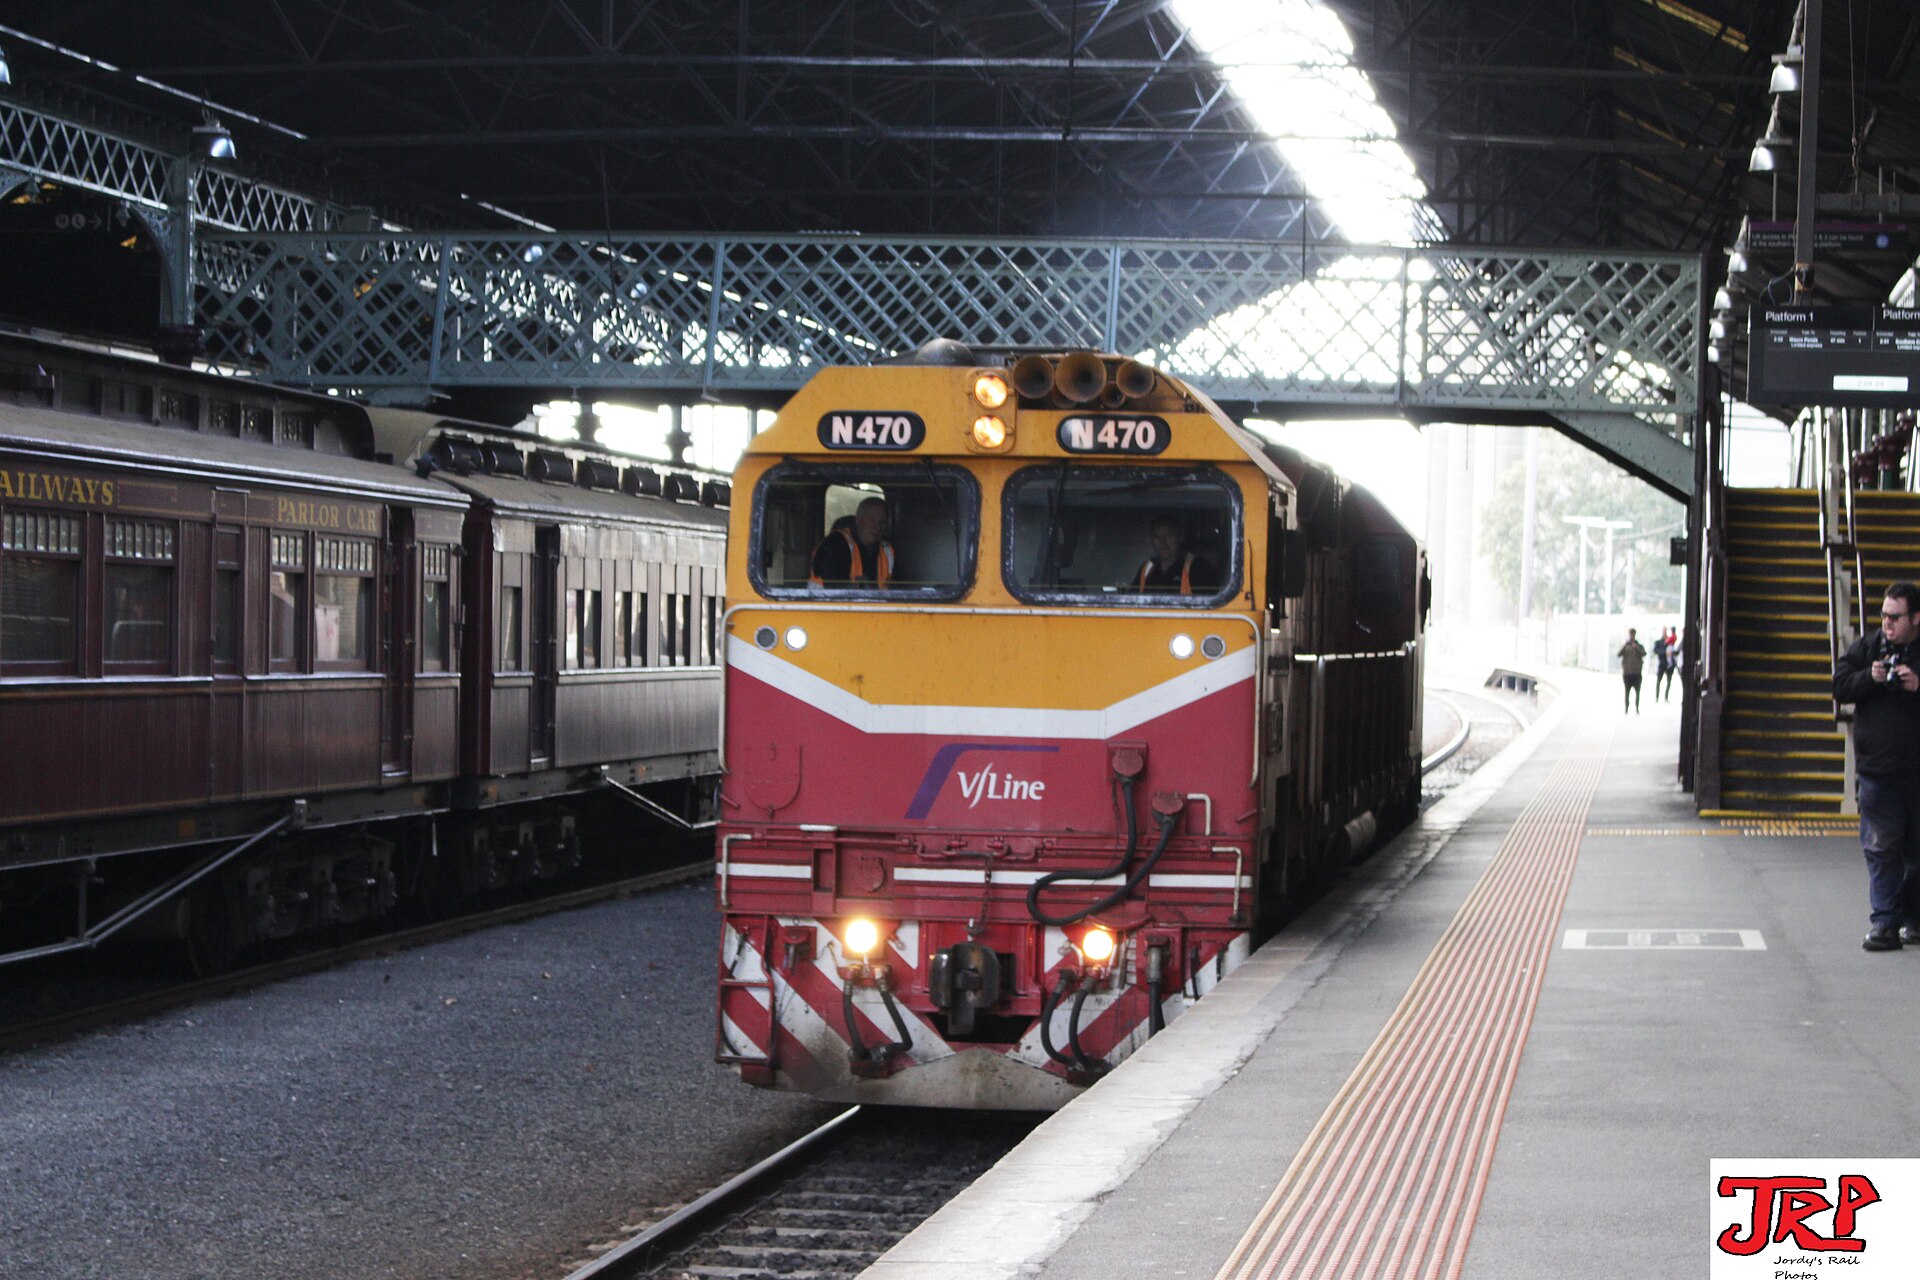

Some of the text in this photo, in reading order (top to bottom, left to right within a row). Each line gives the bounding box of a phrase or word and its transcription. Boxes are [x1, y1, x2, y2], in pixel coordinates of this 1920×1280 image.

[1765, 311, 1814, 322] Platform 1
[0, 469, 114, 507] AILWAYS
[276, 496, 377, 532] PARLOR CAR
[957, 762, 1046, 810] V/Line
